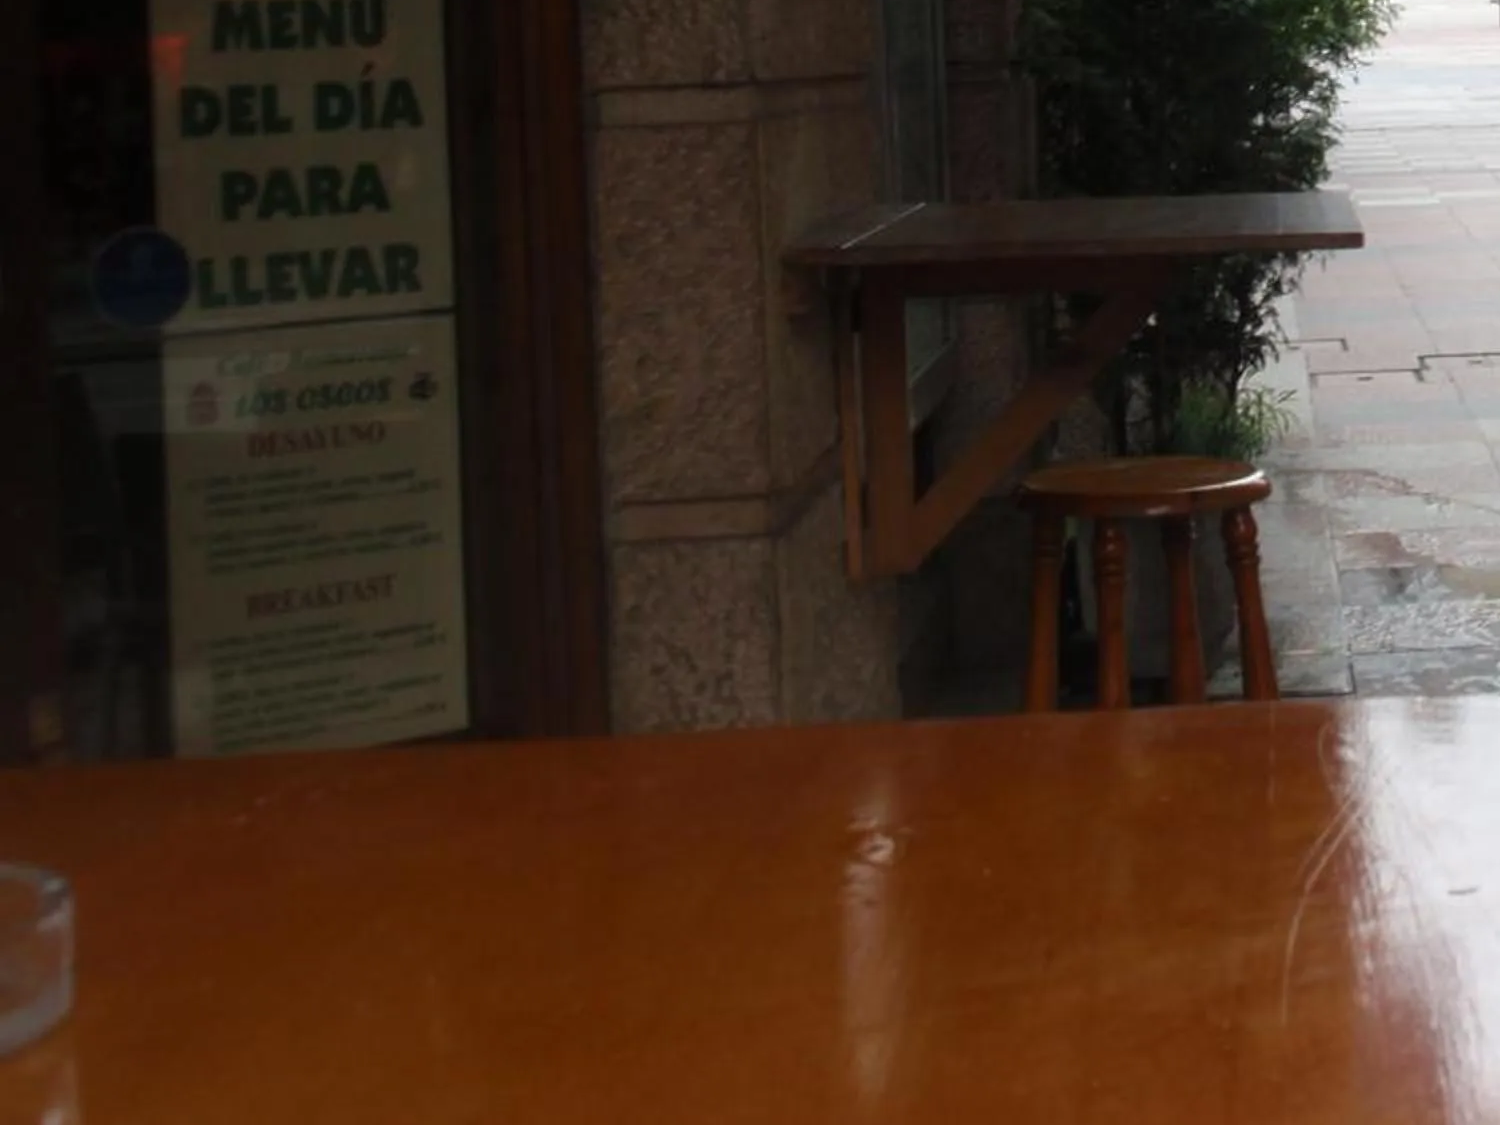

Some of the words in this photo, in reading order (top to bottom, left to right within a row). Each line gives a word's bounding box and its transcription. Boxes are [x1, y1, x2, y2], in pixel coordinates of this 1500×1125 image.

[180, 82, 294, 139] DEL
[313, 63, 424, 132] DÍA
[220, 162, 391, 222] PARA
[195, 243, 423, 310] LLEVAR
